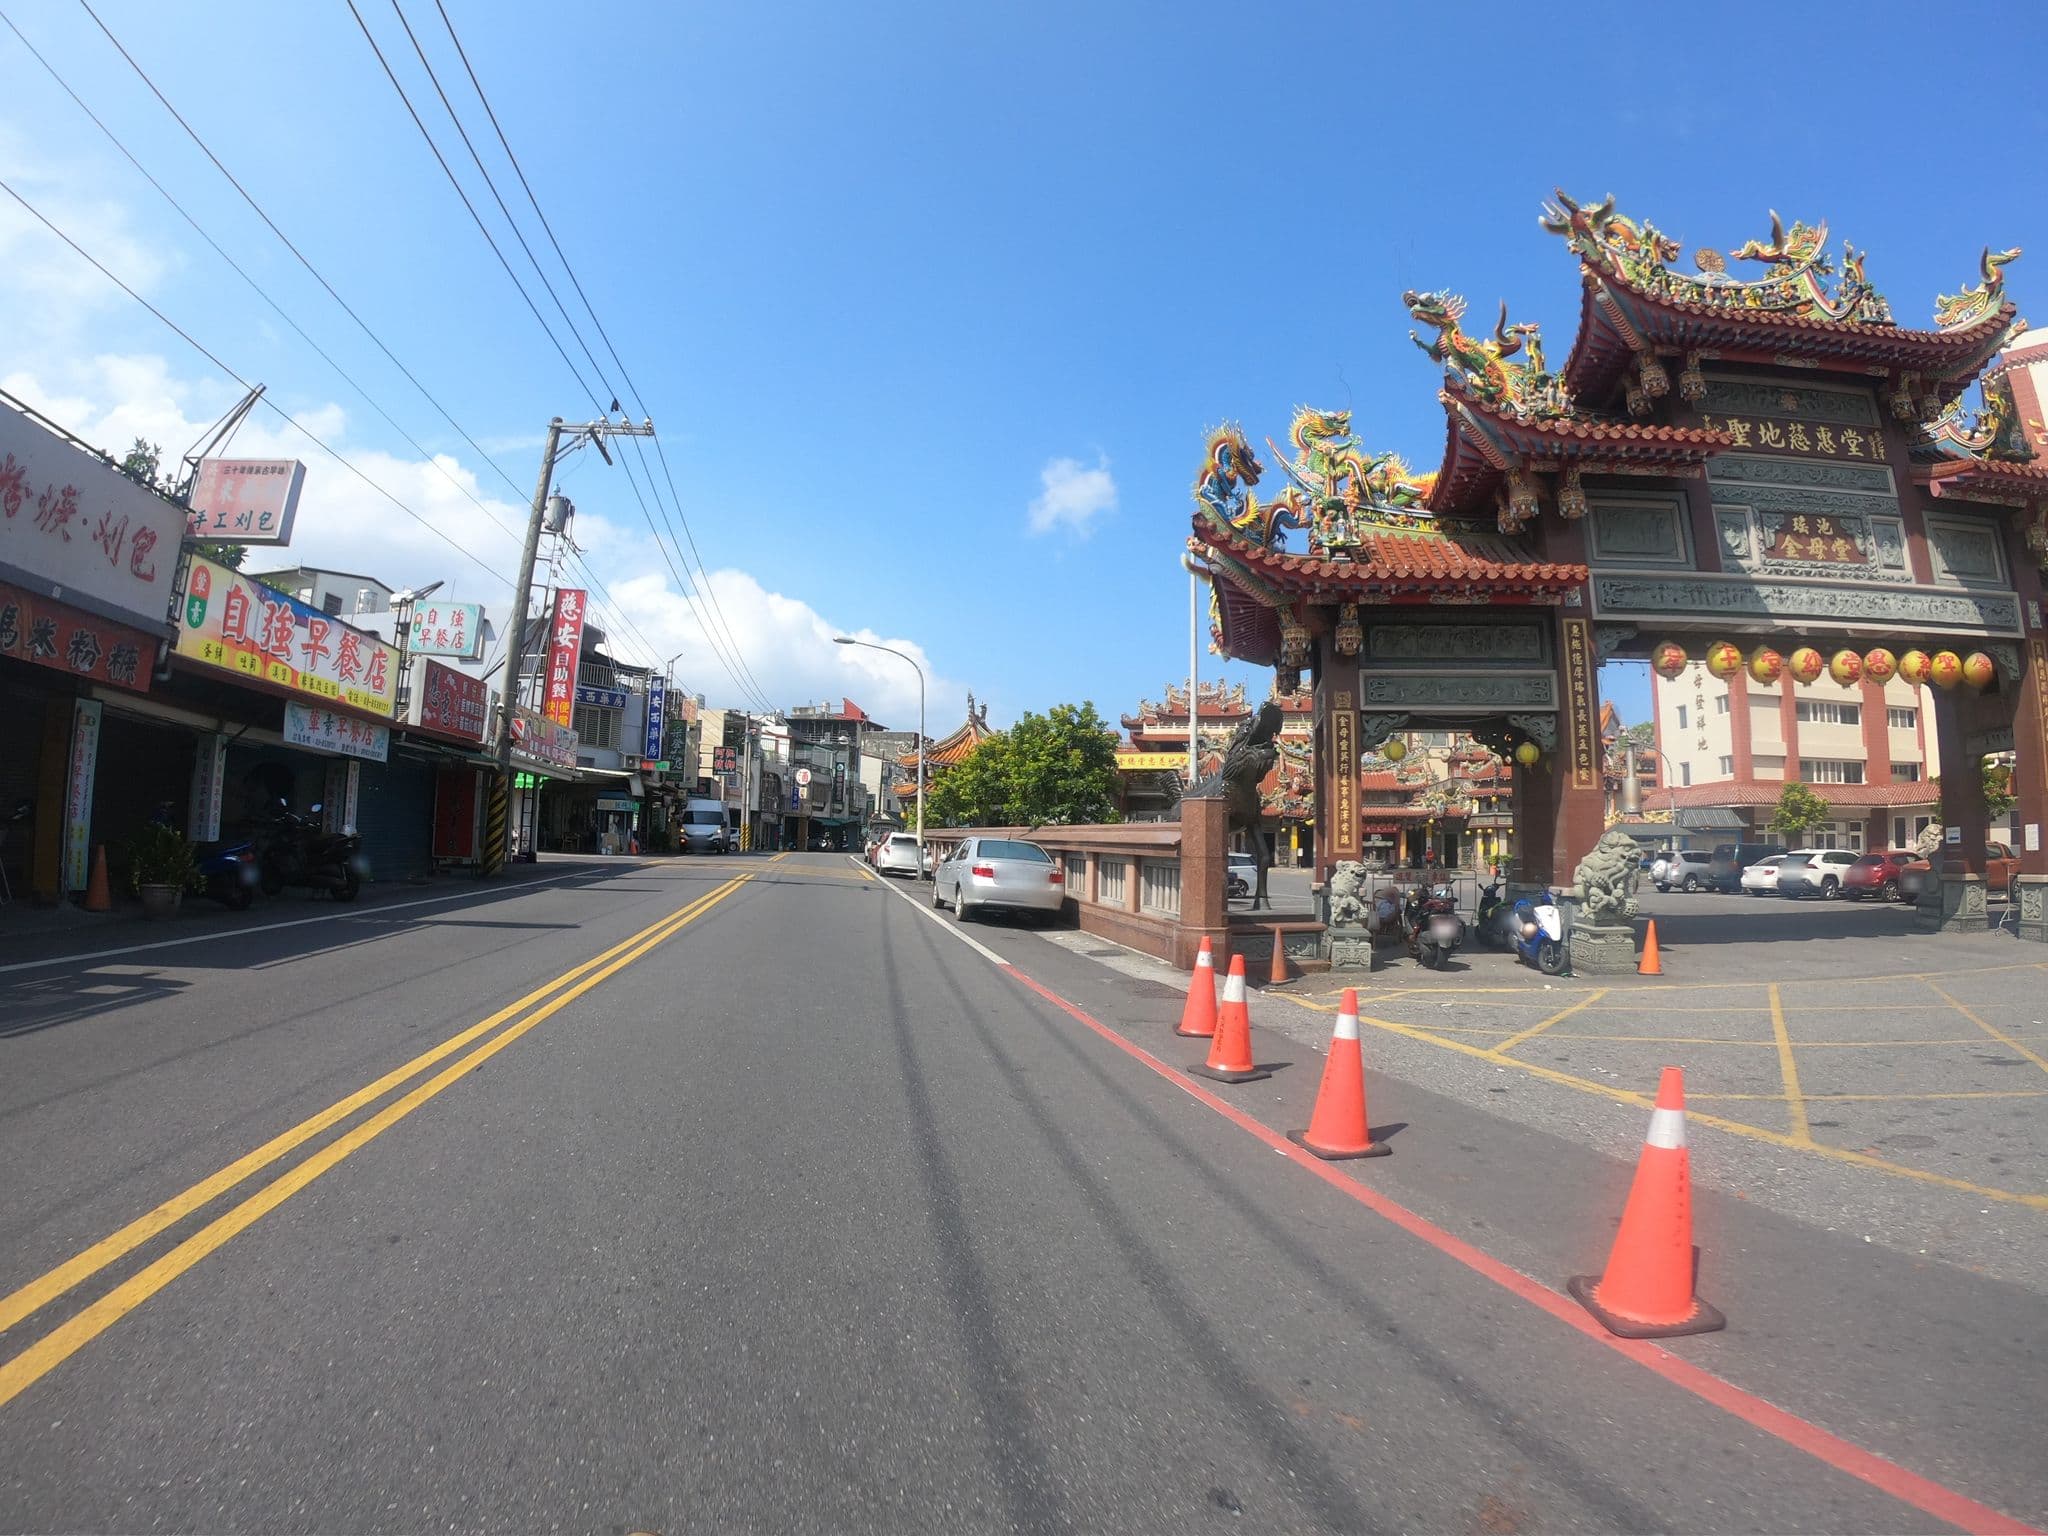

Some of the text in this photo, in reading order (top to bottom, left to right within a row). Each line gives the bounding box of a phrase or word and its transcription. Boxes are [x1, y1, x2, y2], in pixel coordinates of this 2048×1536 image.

[1726, 418, 1864, 457] 聖地慈惠堂
[193, 509, 274, 531] 手工刈包
[1780, 533, 1852, 562] 金母堂
[427, 607, 465, 628] 自強
[223, 584, 389, 695] 自強早餐店
[418, 628, 465, 649] 早餐店
[551, 591, 581, 699] 慈安自助餐
